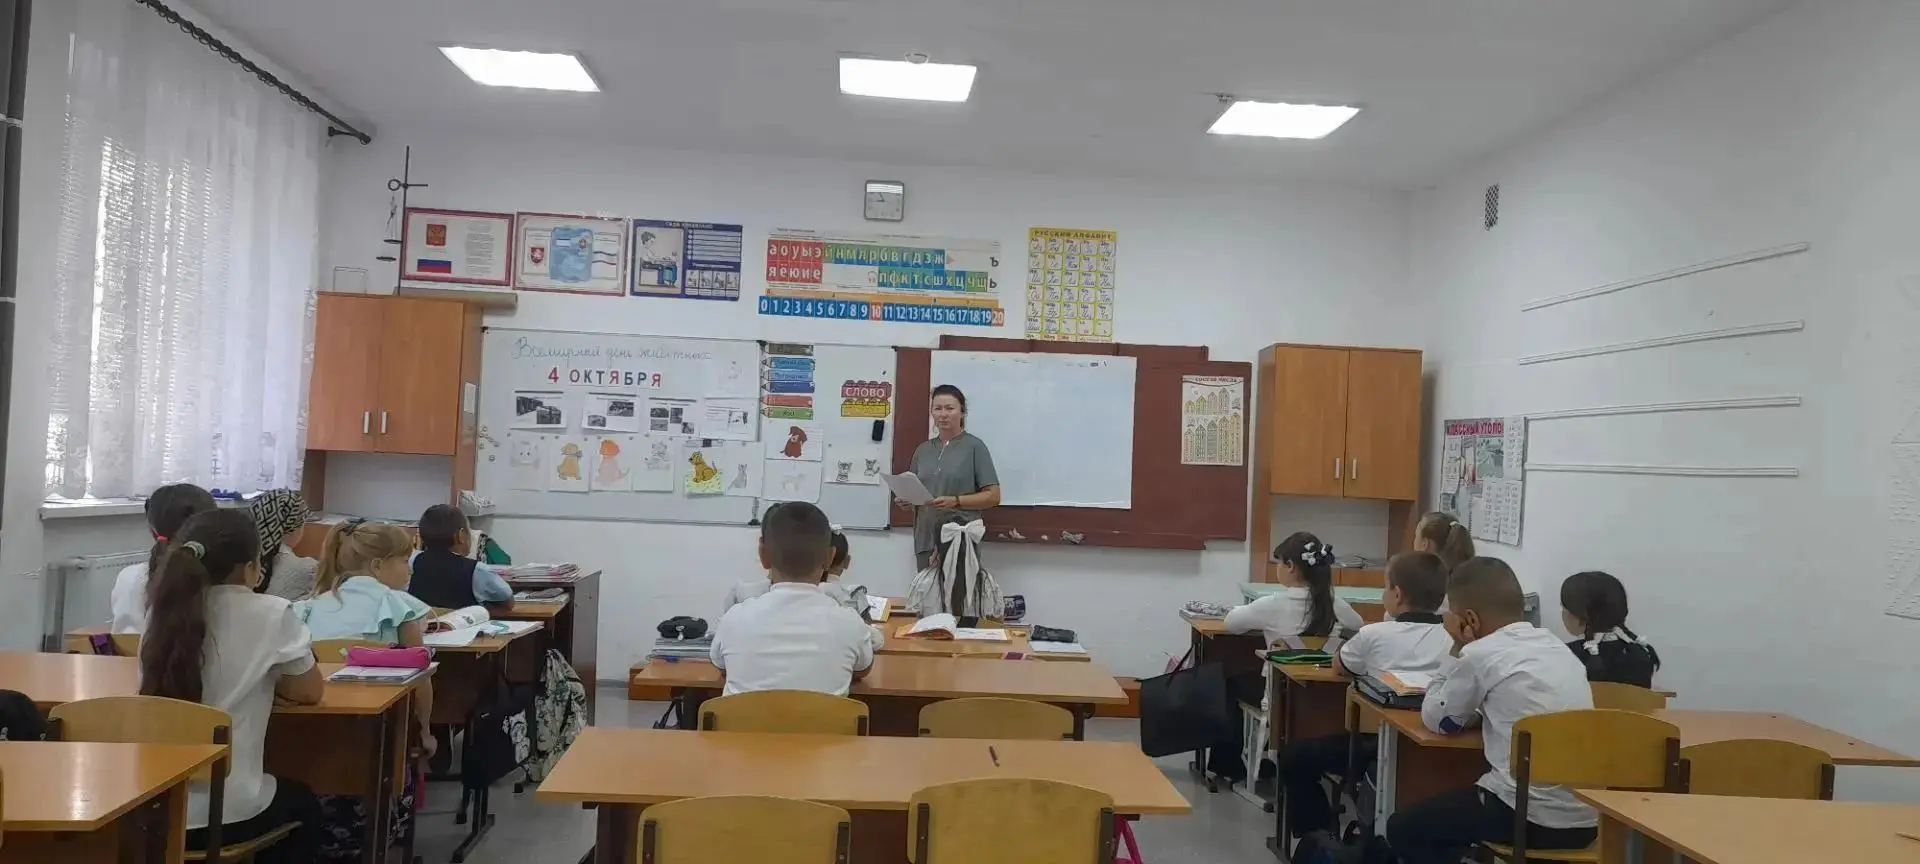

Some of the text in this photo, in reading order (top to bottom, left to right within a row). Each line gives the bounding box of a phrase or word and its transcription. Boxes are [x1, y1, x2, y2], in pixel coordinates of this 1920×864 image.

[761, 300, 1003, 324] 0 1 2 3 4 5 6 7 8 9 10 11 12 13 14 15 16 17 18 19 20
[512, 337, 602, 367] Всемирный
[605, 345, 633, 367] день
[548, 366, 663, 388] 4 ОКТЯБРЯ
[845, 387, 886, 398] СЛОВО
[1447, 421, 1504, 435] КЛАССНЫЙ УГОЛО
